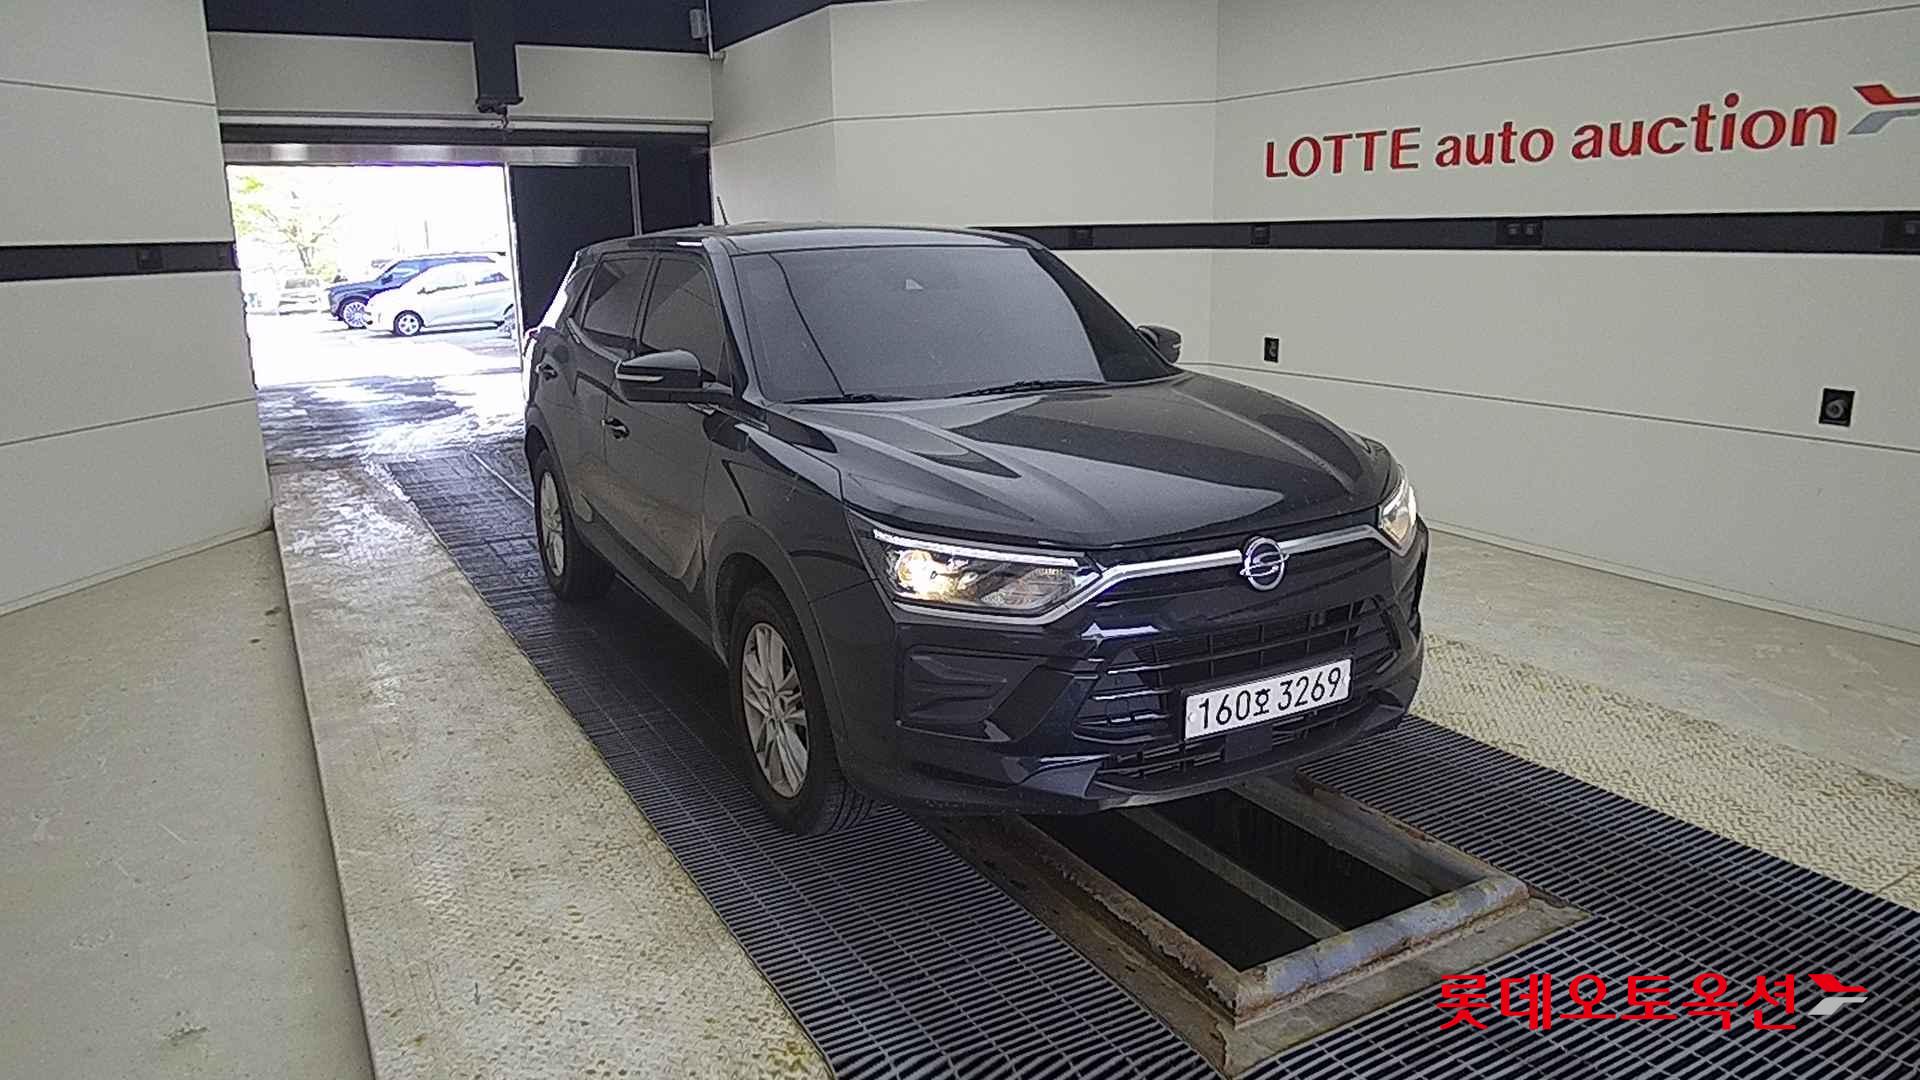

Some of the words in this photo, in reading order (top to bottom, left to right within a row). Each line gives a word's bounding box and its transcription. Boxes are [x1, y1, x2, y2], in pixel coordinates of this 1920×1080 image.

[1266, 127, 1421, 177] LOTTE
[1435, 121, 1555, 167] auto
[1571, 93, 1838, 160] auction
[1199, 689, 1271, 729] 160호
[1278, 667, 1341, 711] 3269
